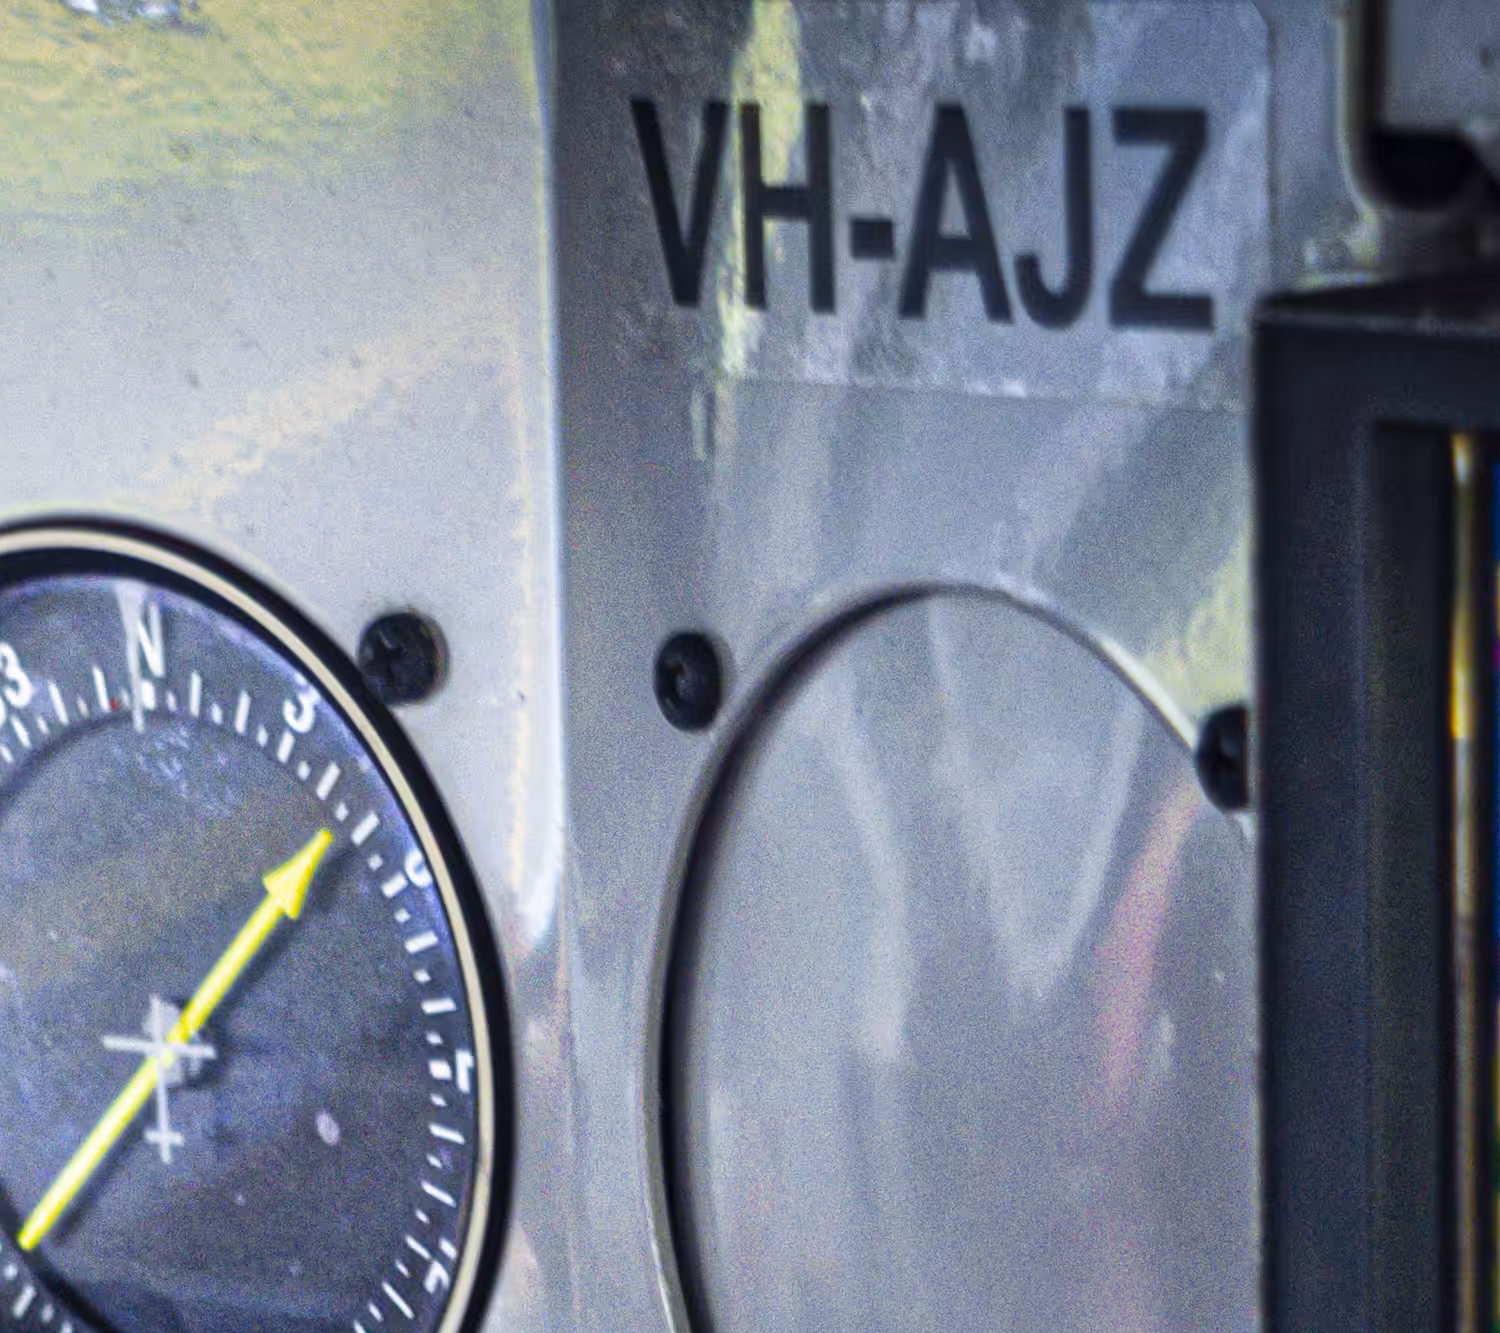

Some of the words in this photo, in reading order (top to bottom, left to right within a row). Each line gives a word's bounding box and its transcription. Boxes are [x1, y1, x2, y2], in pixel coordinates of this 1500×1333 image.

[629, 98, 1213, 332] VH-AJZ
[131, 600, 165, 681] N
[281, 670, 320, 735] 3
